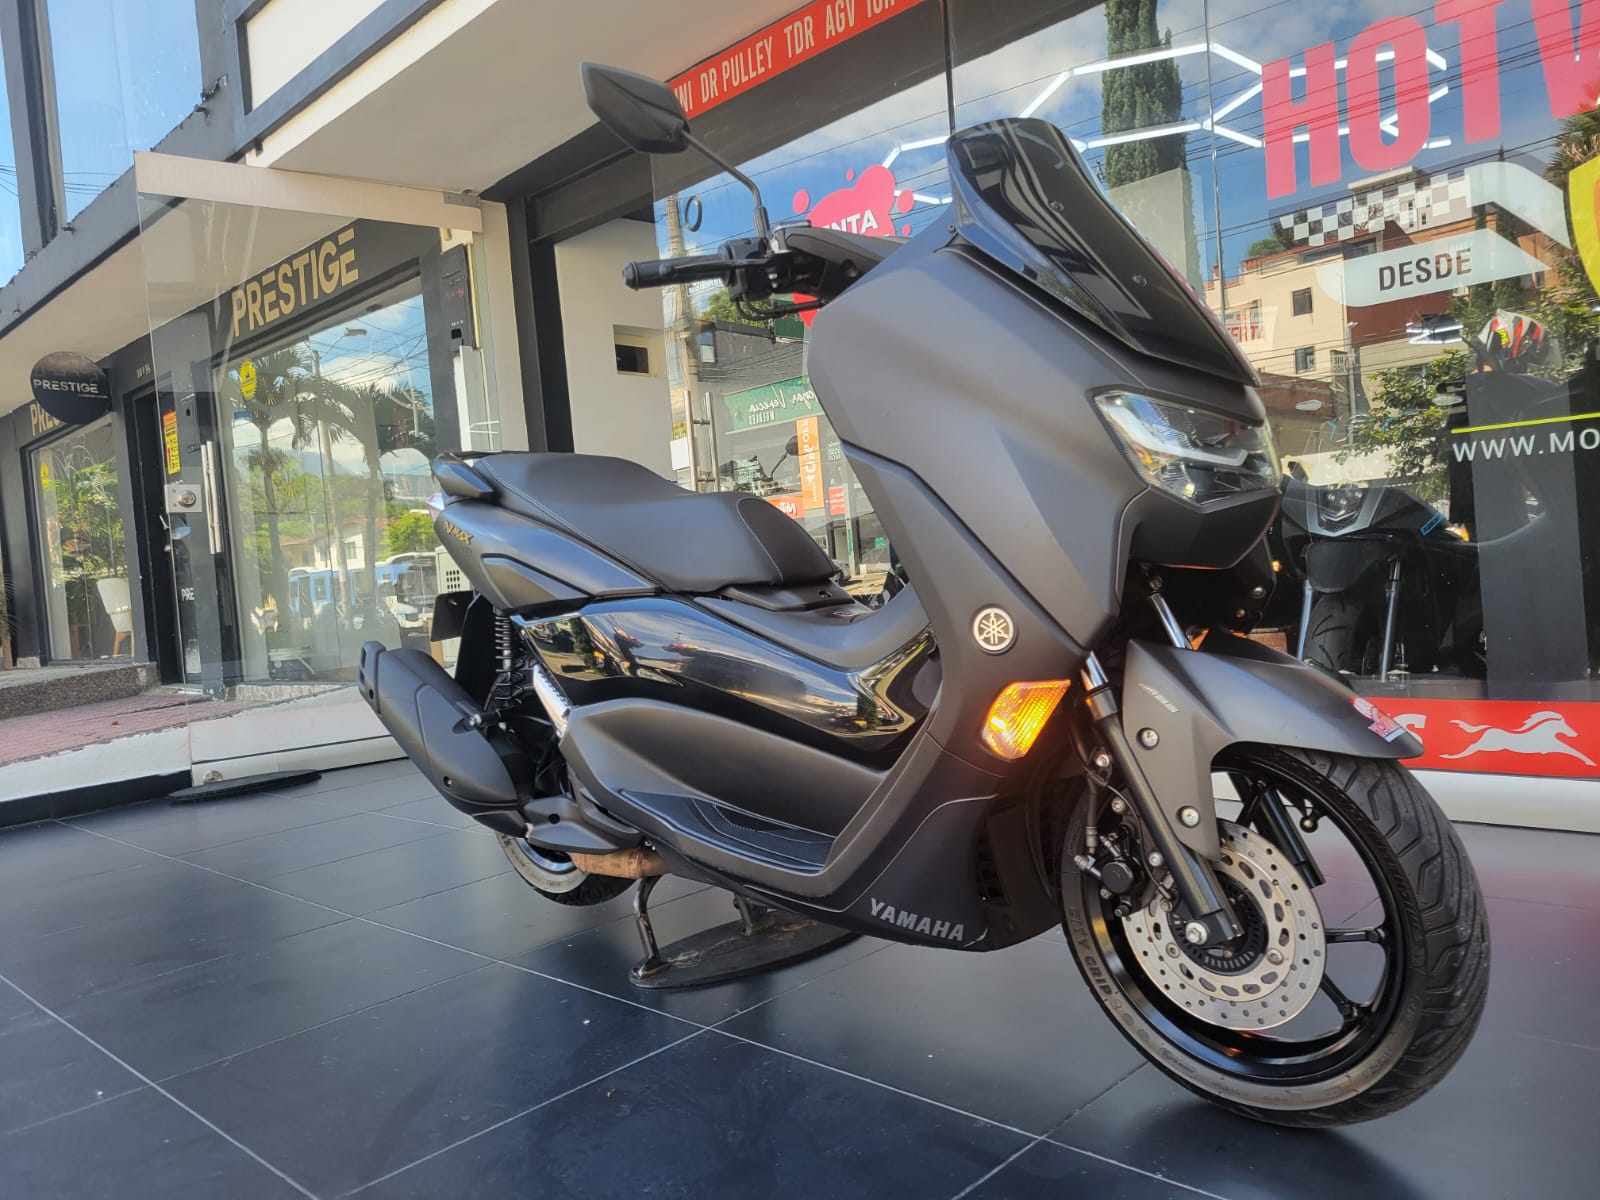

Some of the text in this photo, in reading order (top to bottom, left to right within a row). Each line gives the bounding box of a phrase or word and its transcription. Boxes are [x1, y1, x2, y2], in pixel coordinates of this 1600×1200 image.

[700, 67, 719, 104] DR
[722, 36, 773, 92] PULLEY
[784, 16, 815, 58] TDR
[825, 0, 855, 40] AGV
[231, 227, 359, 337] PRESTIGE
[1379, 247, 1472, 292] DESDE
[33, 379, 100, 394] PRESTIGE
[1453, 428, 1600, 463] WWW.MO
[871, 897, 964, 942] YAMAHA
[1084, 955, 1113, 996] GRIP
